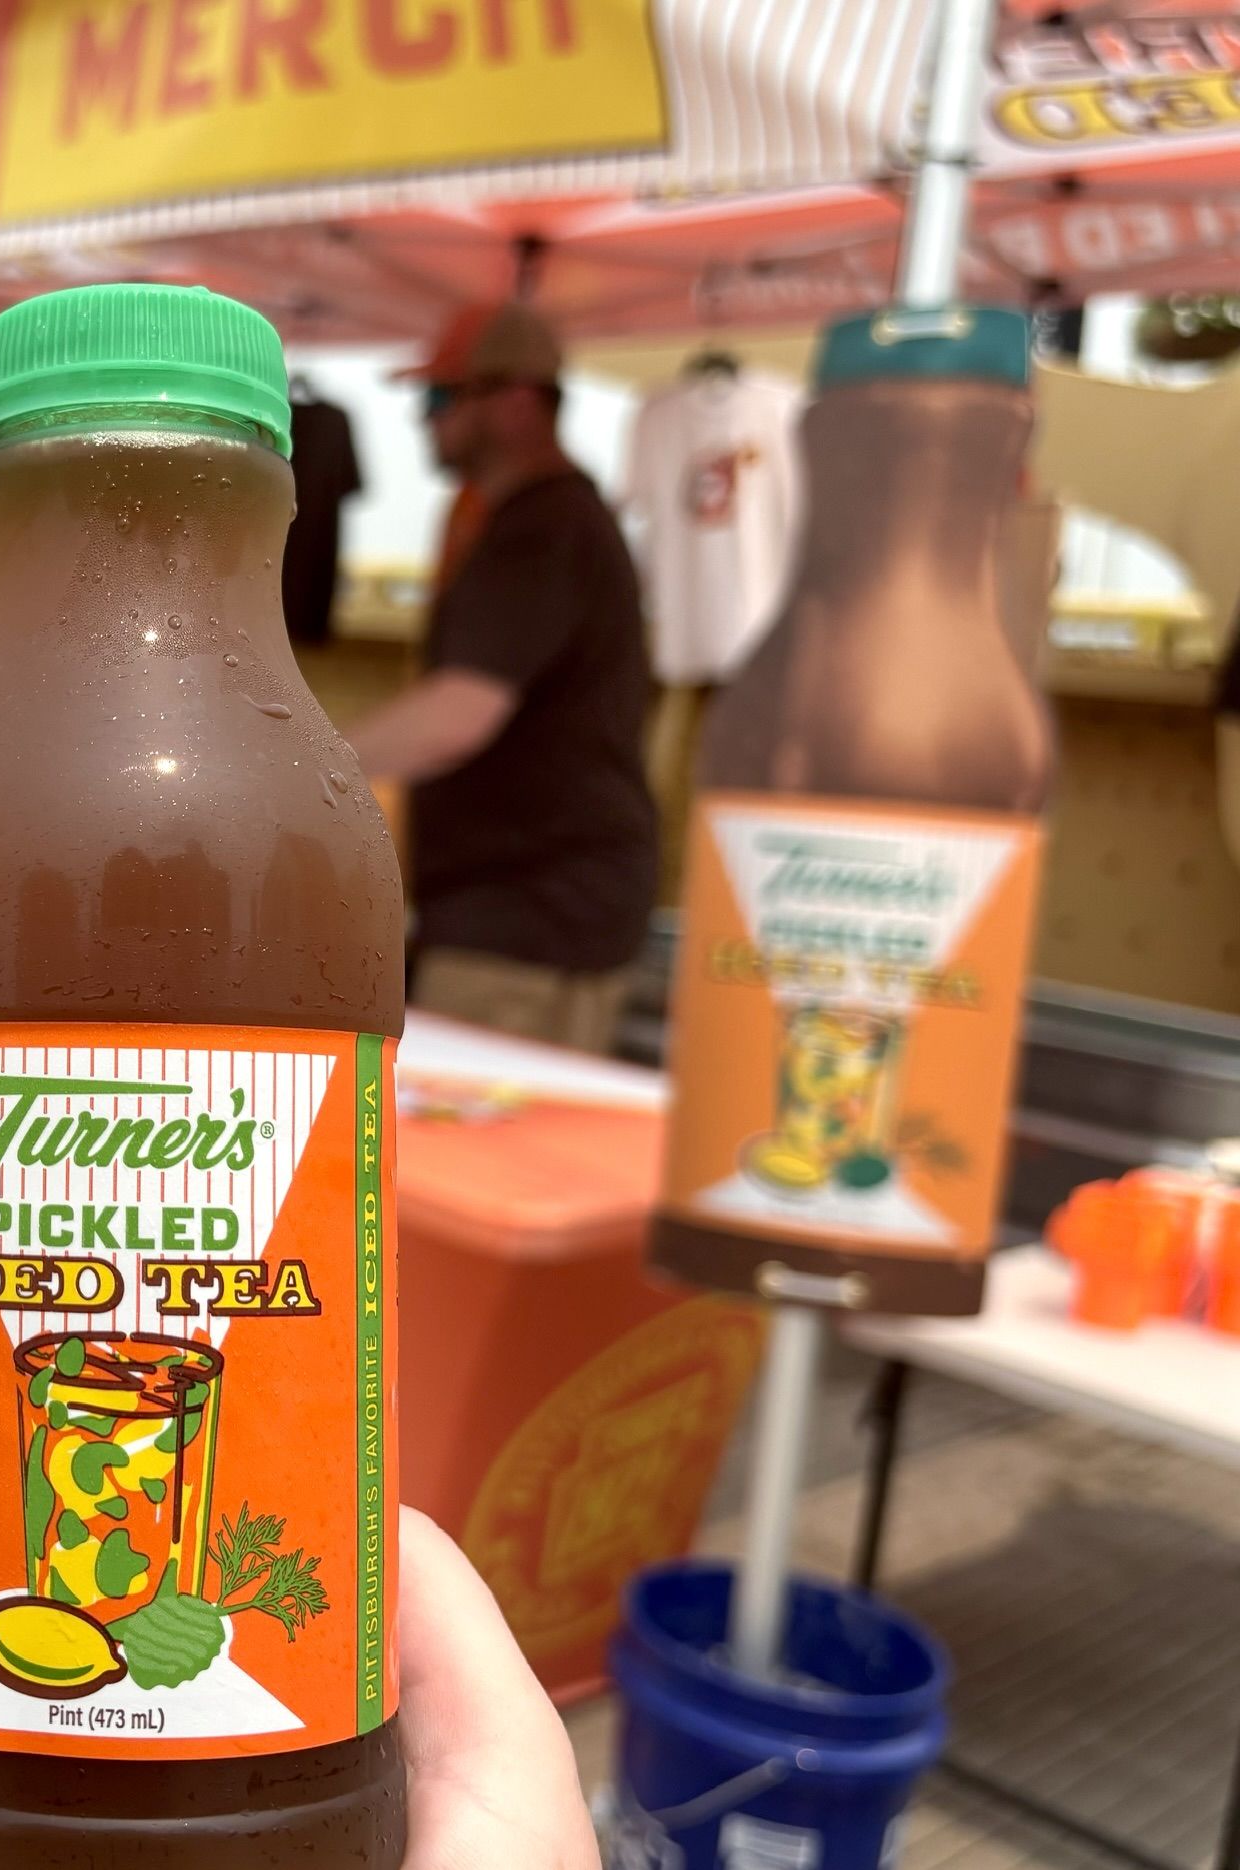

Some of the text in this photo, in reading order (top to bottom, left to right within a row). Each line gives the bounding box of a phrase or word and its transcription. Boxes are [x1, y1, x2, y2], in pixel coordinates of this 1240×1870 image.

[145, 1257, 322, 1316] TEA
[364, 1078, 378, 1701] PITTSBURGH'S FAVORITE ICED TEA
[48, 1704, 165, 1734] Pint (473 mL)
